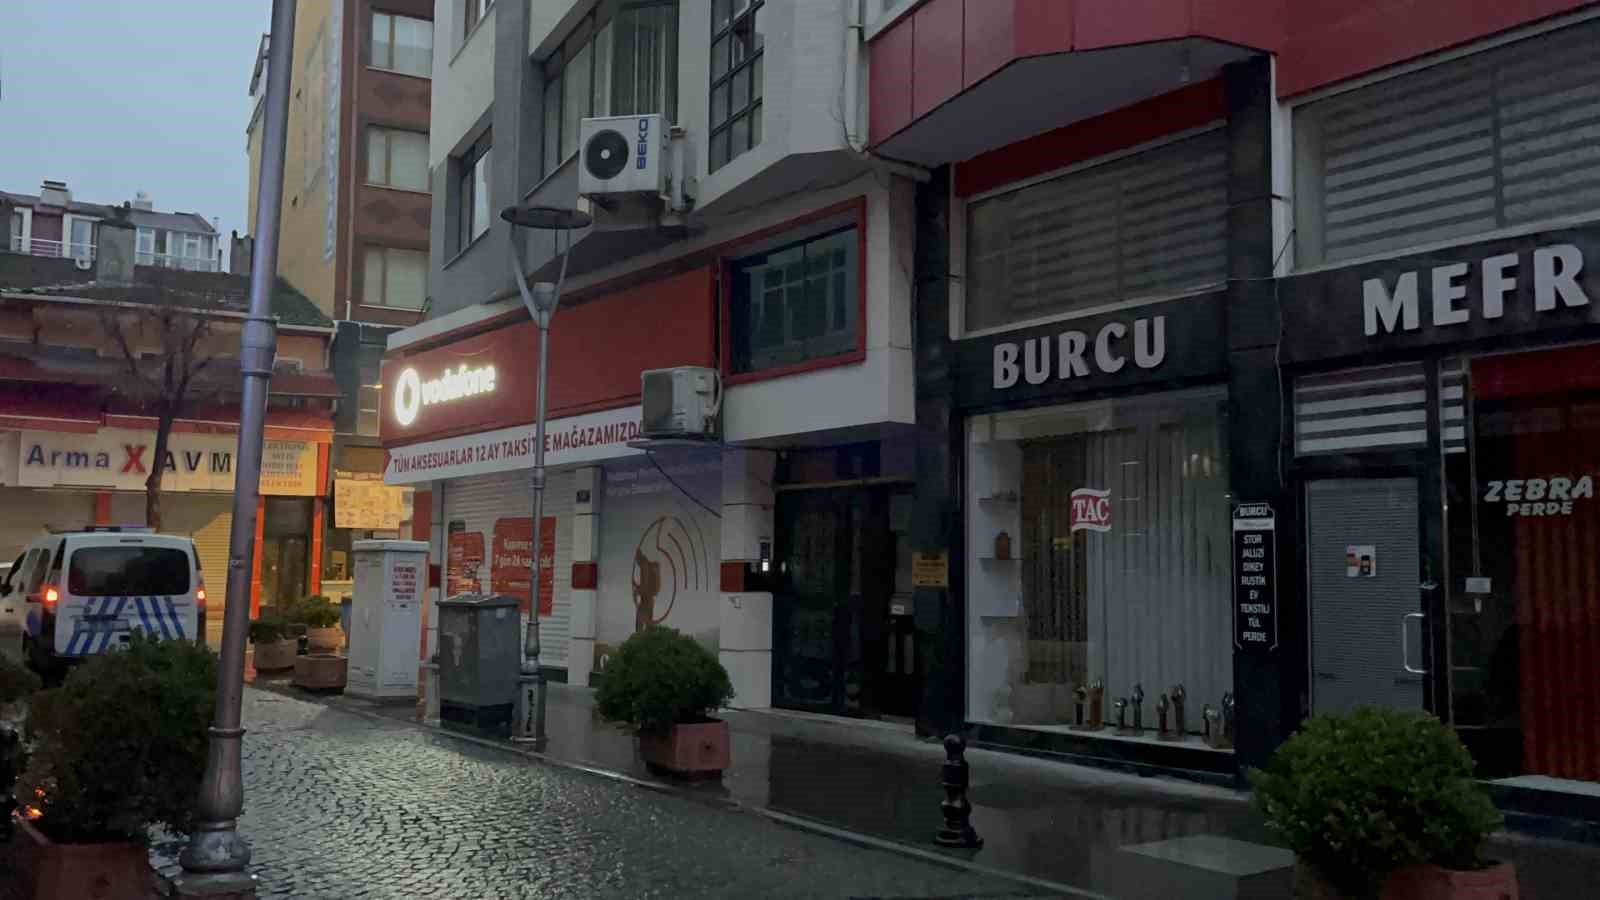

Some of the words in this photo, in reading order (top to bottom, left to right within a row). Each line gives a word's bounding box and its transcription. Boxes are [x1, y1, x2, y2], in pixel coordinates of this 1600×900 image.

[636, 118, 649, 170] BEKO
[1362, 243, 1589, 337] MEFR
[993, 315, 1166, 390] BURCU
[422, 364, 496, 405] vodafone
[27, 444, 110, 468] Arma
[162, 450, 231, 473] AVM
[411, 447, 473, 470] AKSESUARLAR
[475, 445, 486, 461] 12
[487, 442, 500, 461] AY
[1483, 475, 1593, 503] ZEBRA
[1505, 501, 1574, 516] PERDE
[1243, 534, 1263, 545] STOR
